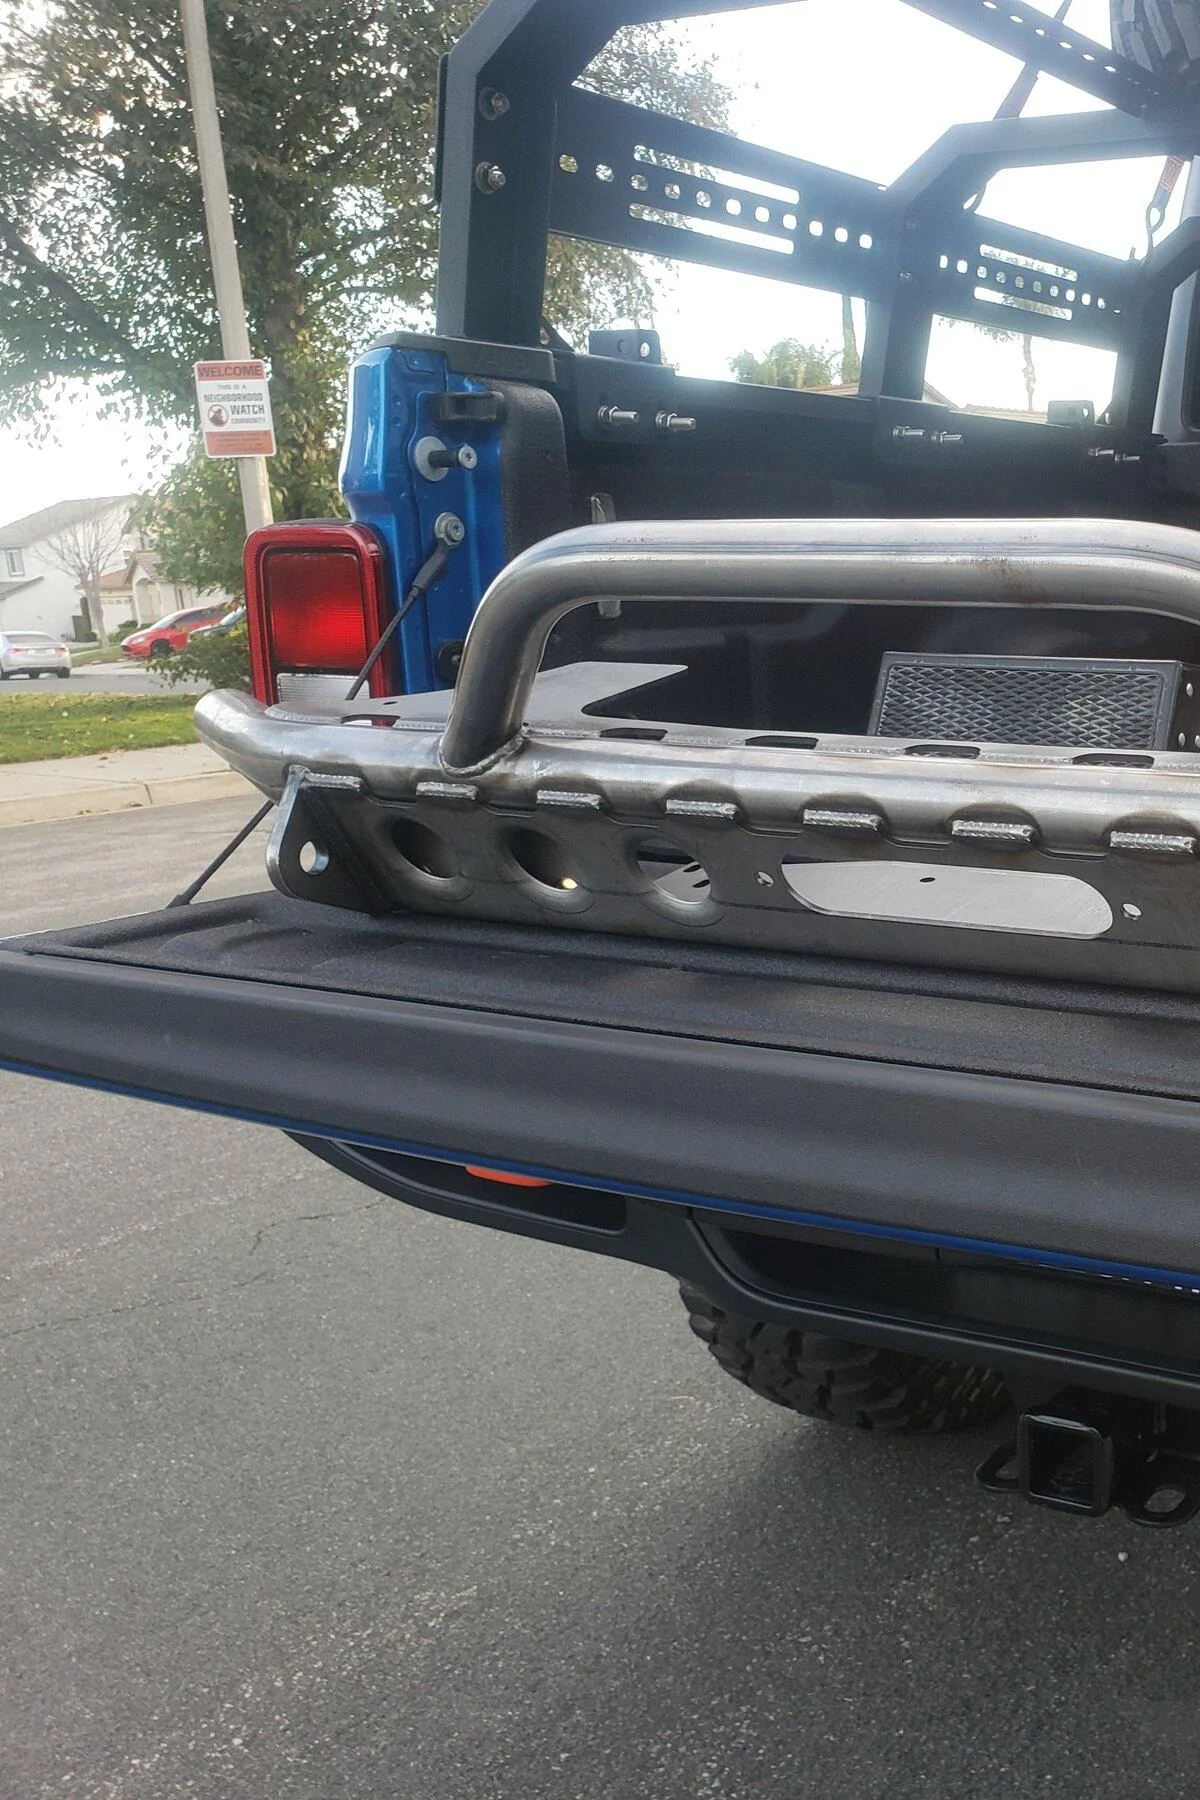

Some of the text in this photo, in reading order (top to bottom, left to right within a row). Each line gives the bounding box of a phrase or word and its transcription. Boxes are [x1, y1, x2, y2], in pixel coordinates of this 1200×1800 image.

[197, 365, 262, 378] WELCOME
[203, 392, 263, 403] NEIGHBORHOOD
[229, 404, 265, 416] WATCH
